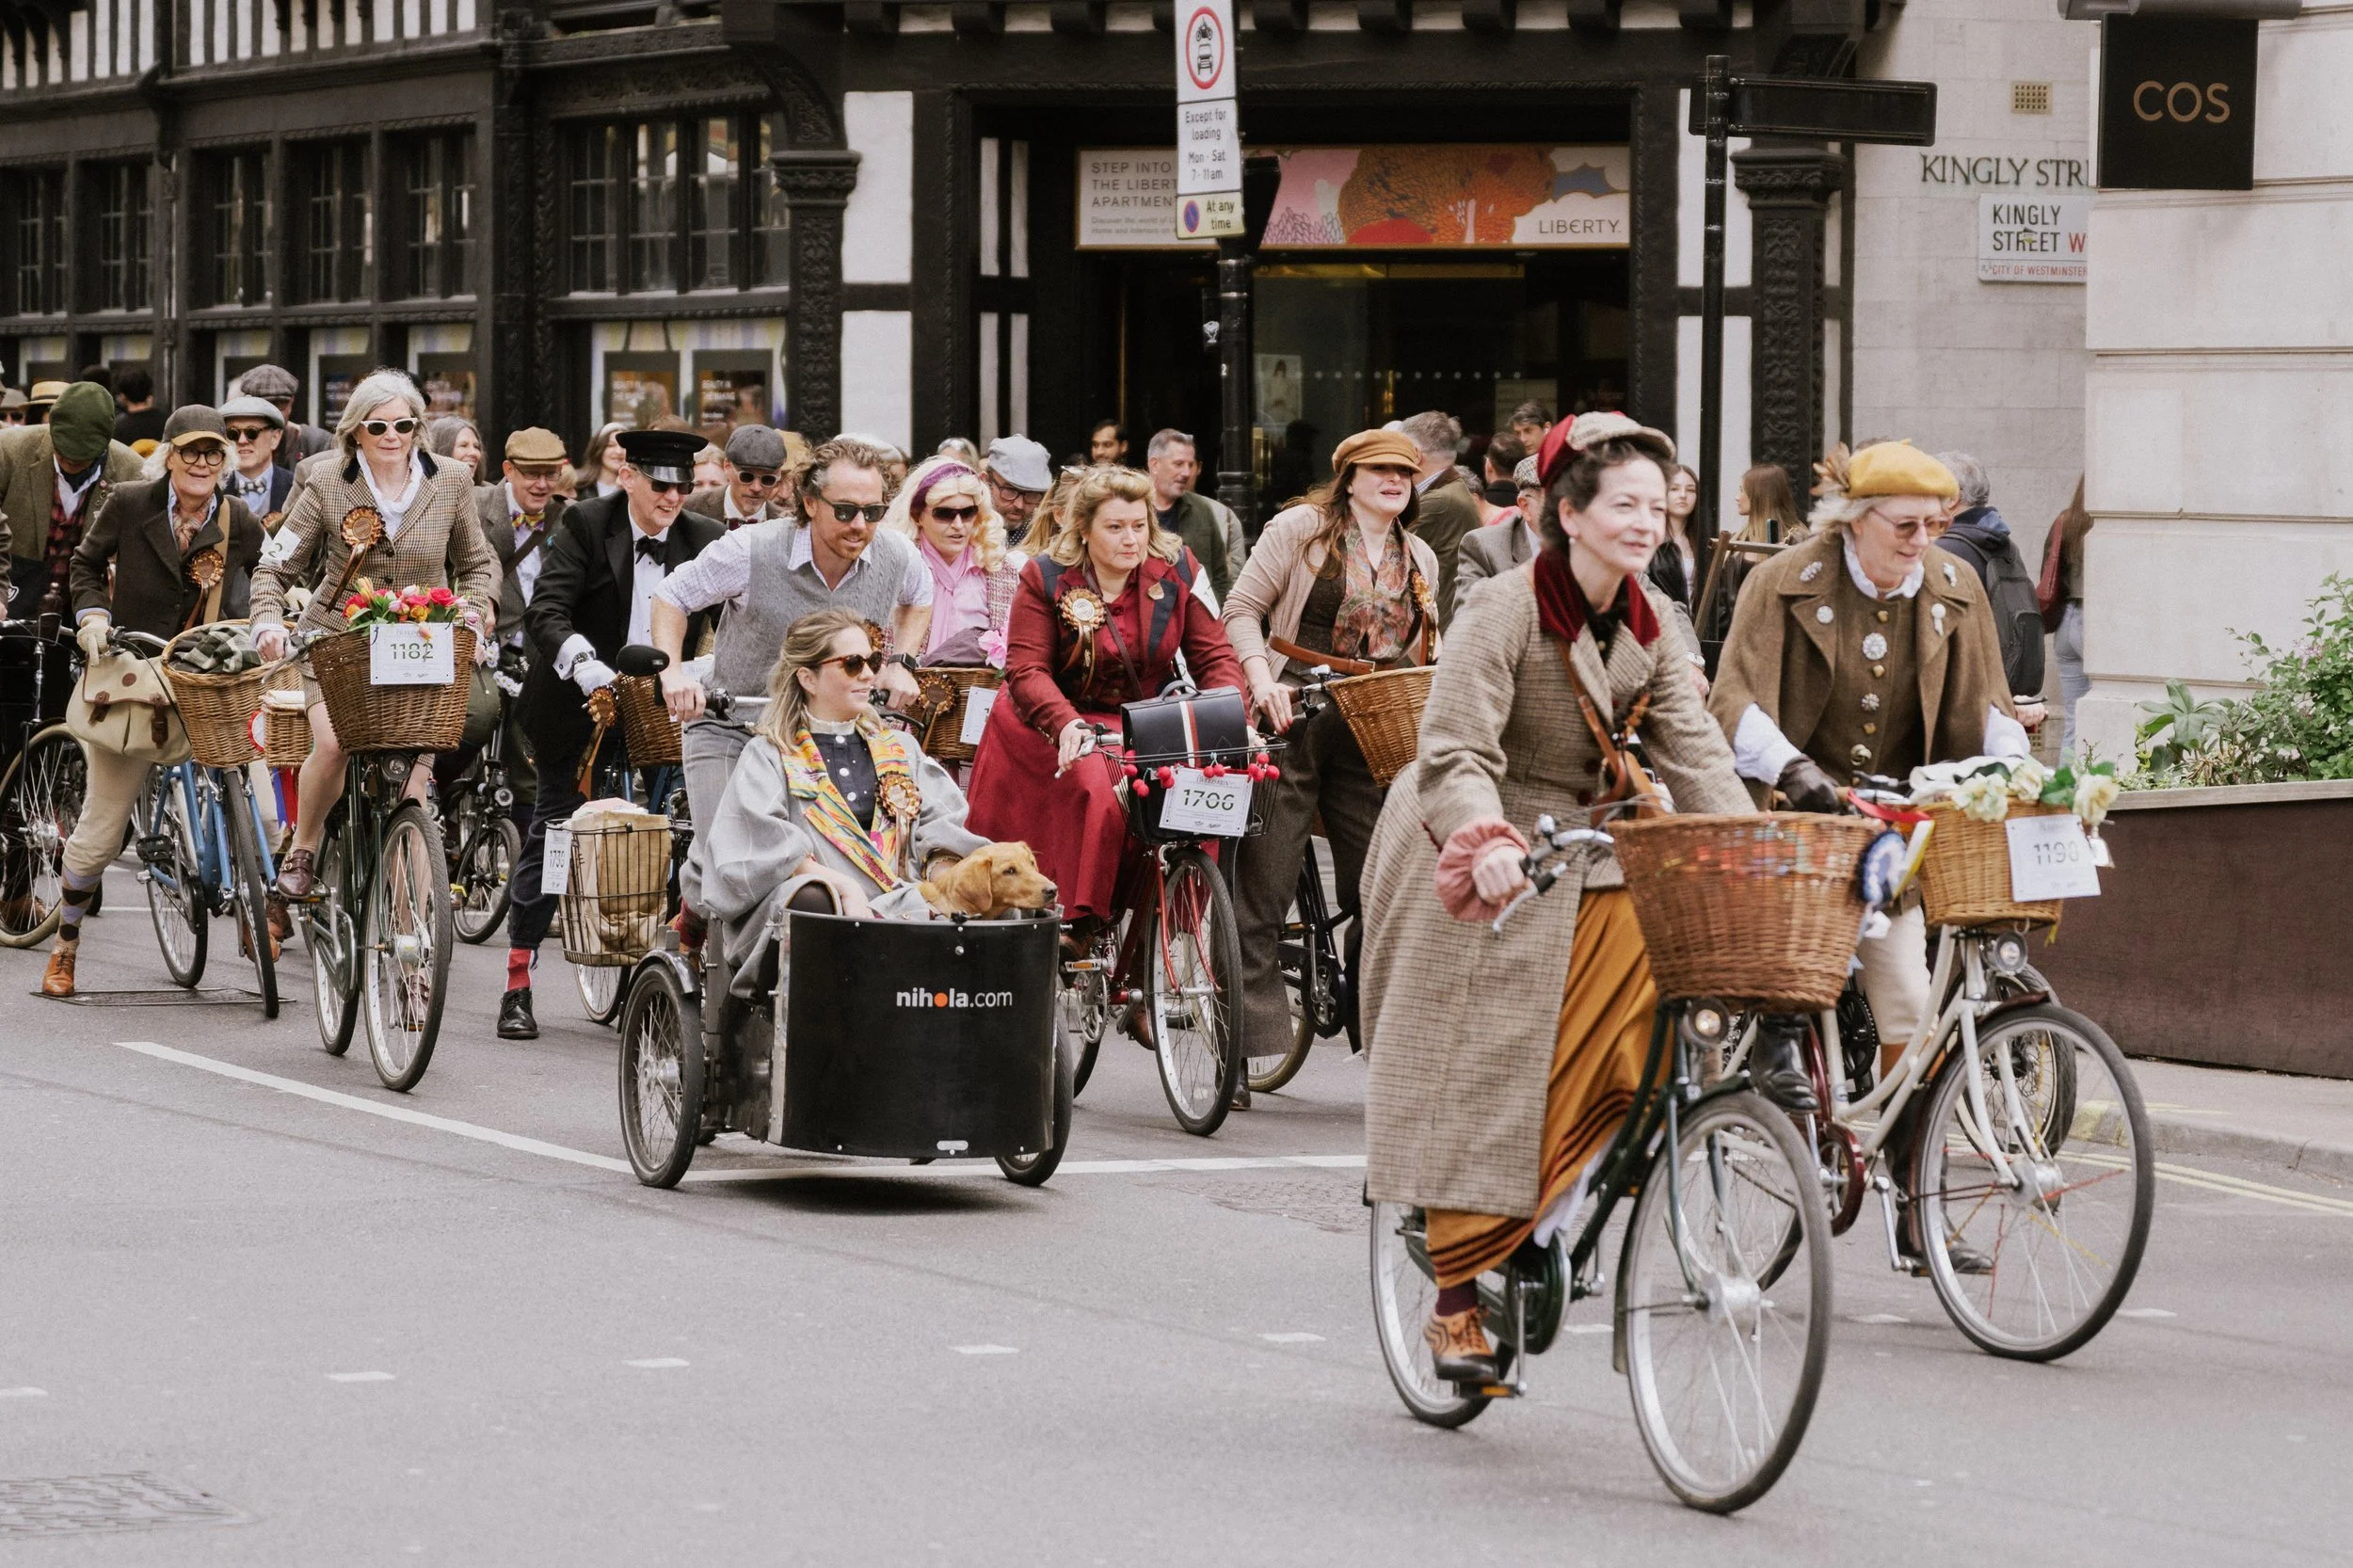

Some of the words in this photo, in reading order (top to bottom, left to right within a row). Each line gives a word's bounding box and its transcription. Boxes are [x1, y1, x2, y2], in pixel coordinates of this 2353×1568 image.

[2133, 80, 2231, 123] COS
[1185, 109, 1213, 124] Except
[1215, 108, 1226, 120] for
[1192, 127, 1222, 141] loading
[1188, 152, 1205, 165] Mon
[1211, 149, 1226, 163] Sat
[1091, 161, 1129, 174] STEP
[1136, 161, 1172, 174] INTO
[1919, 152, 2029, 186] KINGLY
[2035, 158, 2089, 187] STR
[1091, 179, 1120, 190] THE
[1206, 199, 1216, 213] At
[1219, 200, 1235, 214] any
[1993, 203, 2062, 227] KINGLY
[1210, 217, 1231, 230] time
[1993, 230, 2061, 253] STREET
[1992, 264, 2010, 276] CITY
[2013, 264, 2024, 276] OF
[2027, 265, 2087, 277] WESTMINSTER
[390, 642, 434, 660] 1182
[1183, 789, 1235, 811] 1706
[895, 986, 1014, 1008] nihola.com
